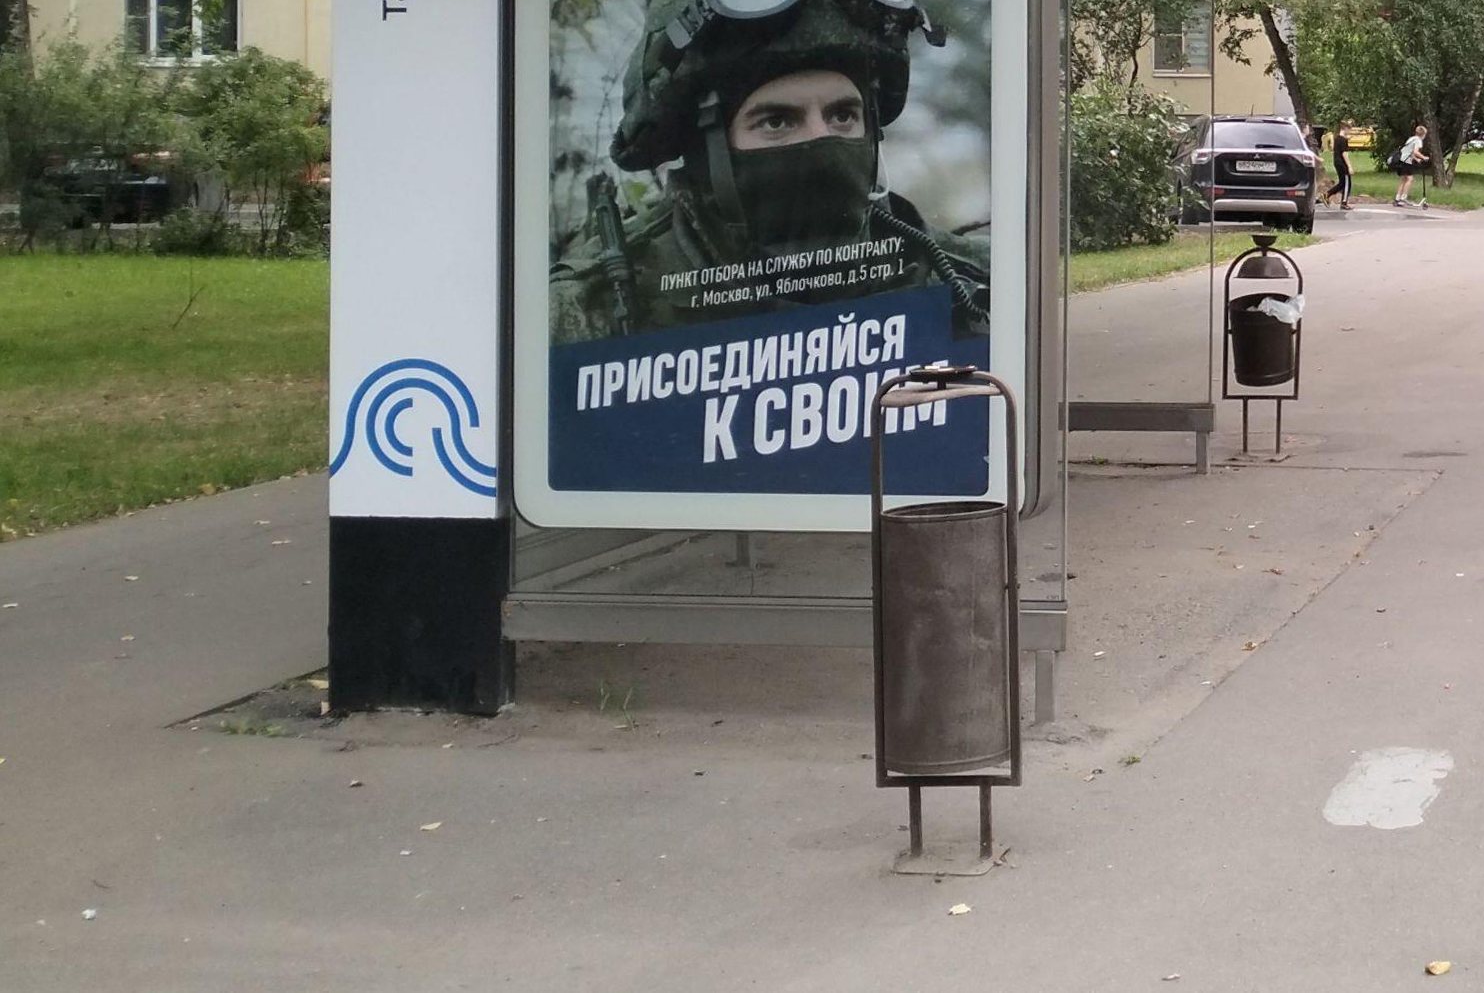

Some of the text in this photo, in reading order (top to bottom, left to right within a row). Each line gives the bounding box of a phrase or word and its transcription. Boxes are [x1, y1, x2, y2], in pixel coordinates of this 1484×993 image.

[660, 236, 905, 291] ПУНКТ ОТБОРА НА СЛУЖБУ ПО КОНТРАКТУ:
[690, 295, 700, 308] г.
[702, 289, 754, 306] Москва,
[756, 284, 773, 301] ул.
[775, 272, 846, 296] Яблочкова,
[869, 263, 895, 281] стр.
[898, 258, 905, 275] 1
[576, 312, 906, 411] ПРИСОЕДИНЯЙСЯ
[702, 395, 738, 463] К
